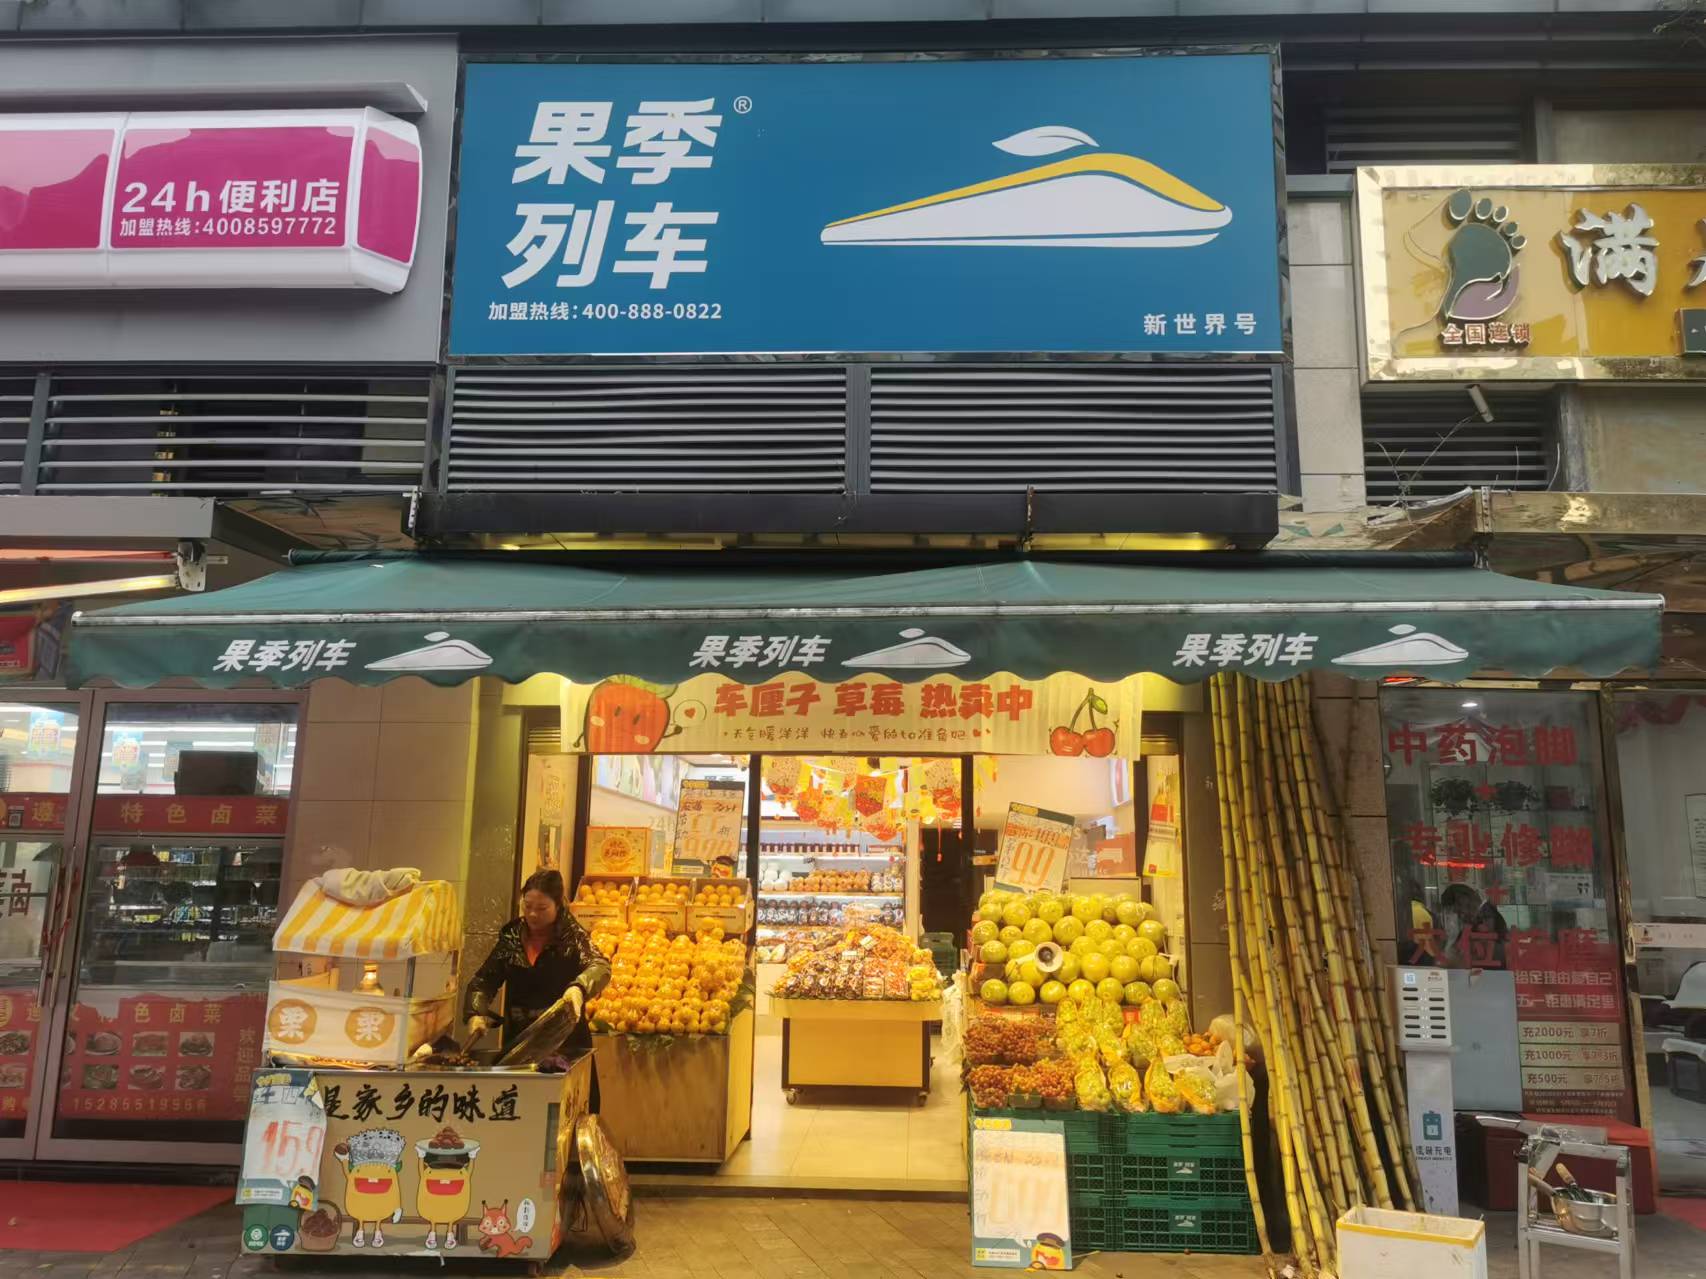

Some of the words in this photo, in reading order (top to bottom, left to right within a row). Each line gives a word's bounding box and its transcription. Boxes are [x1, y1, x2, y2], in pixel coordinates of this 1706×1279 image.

[512, 98, 723, 184] 果季
[119, 216, 337, 238] 加盟热线:4008597772
[501, 200, 719, 289] 列车
[488, 302, 722, 321] 加盟热线:400-888-0822
[1143, 313, 1257, 336] 新世界号
[1441, 321, 1530, 346] 全国连锁
[213, 639, 357, 672] 果季列车
[689, 635, 832, 668] 果季列车
[1172, 632, 1319, 667] 果季列车
[714, 682, 821, 717] 车厘子
[833, 682, 904, 717] 草莓
[920, 683, 1033, 721] 热卖中
[1388, 722, 1578, 768] 中药泡脚
[120, 802, 279, 825] 特色卤菜
[1523, 1026, 1575, 1039] 充2000元
[1525, 1049, 1573, 1062] 充1000元
[1527, 1072, 1568, 1085] 充500元
